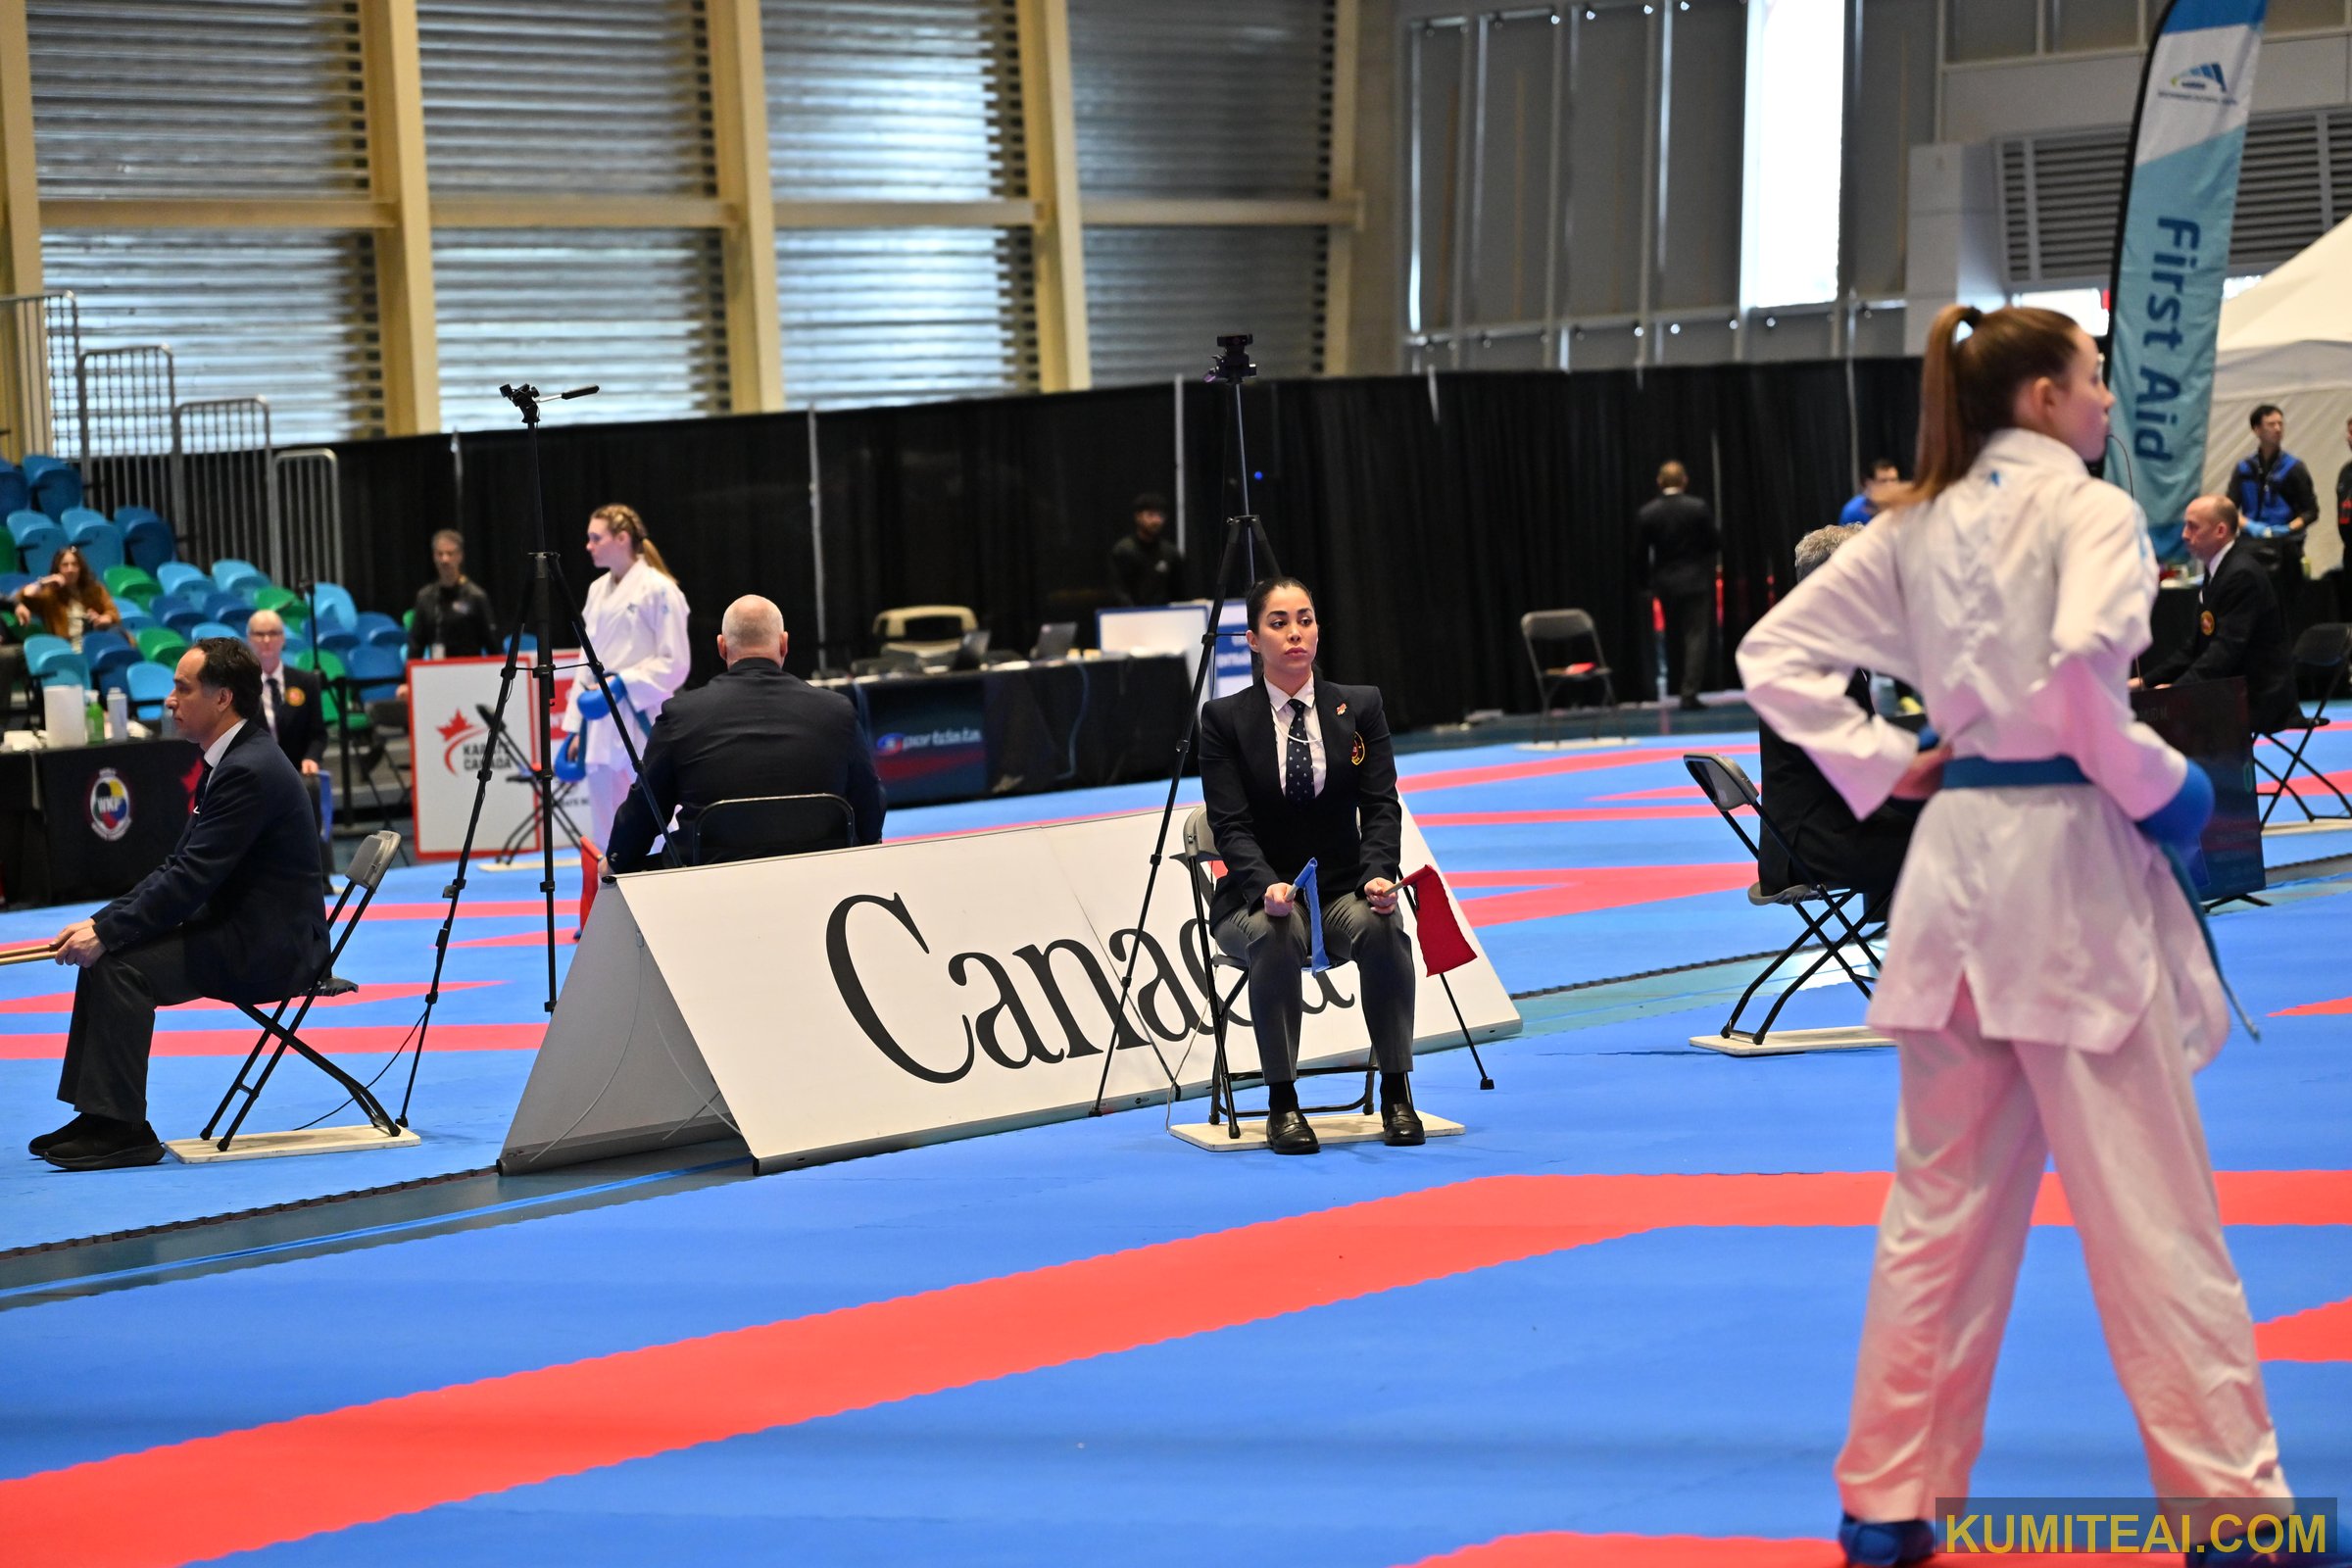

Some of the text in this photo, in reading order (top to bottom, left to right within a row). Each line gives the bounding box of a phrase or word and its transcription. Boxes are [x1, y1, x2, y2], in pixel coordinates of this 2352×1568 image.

[2134, 217, 2200, 463] First Aid
[464, 757, 512, 770] CADA
